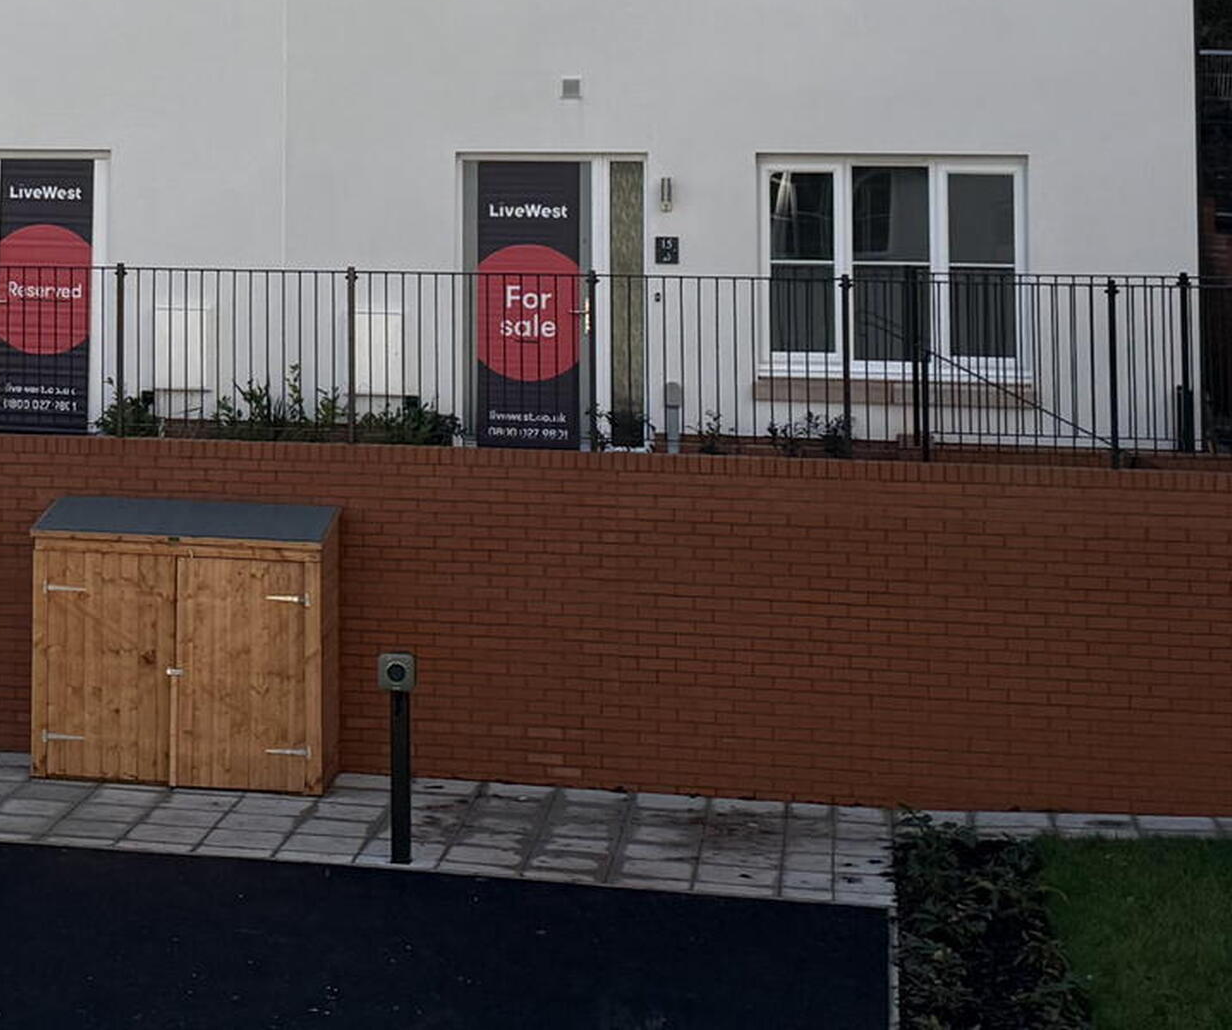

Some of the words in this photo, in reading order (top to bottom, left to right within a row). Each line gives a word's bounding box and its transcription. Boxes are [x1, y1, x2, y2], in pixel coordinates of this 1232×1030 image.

[9, 185, 82, 200] LiveWest
[489, 204, 568, 219] LiveWest
[8, 280, 82, 298] Reserved
[505, 286, 552, 309] For
[500, 314, 556, 337] sale
